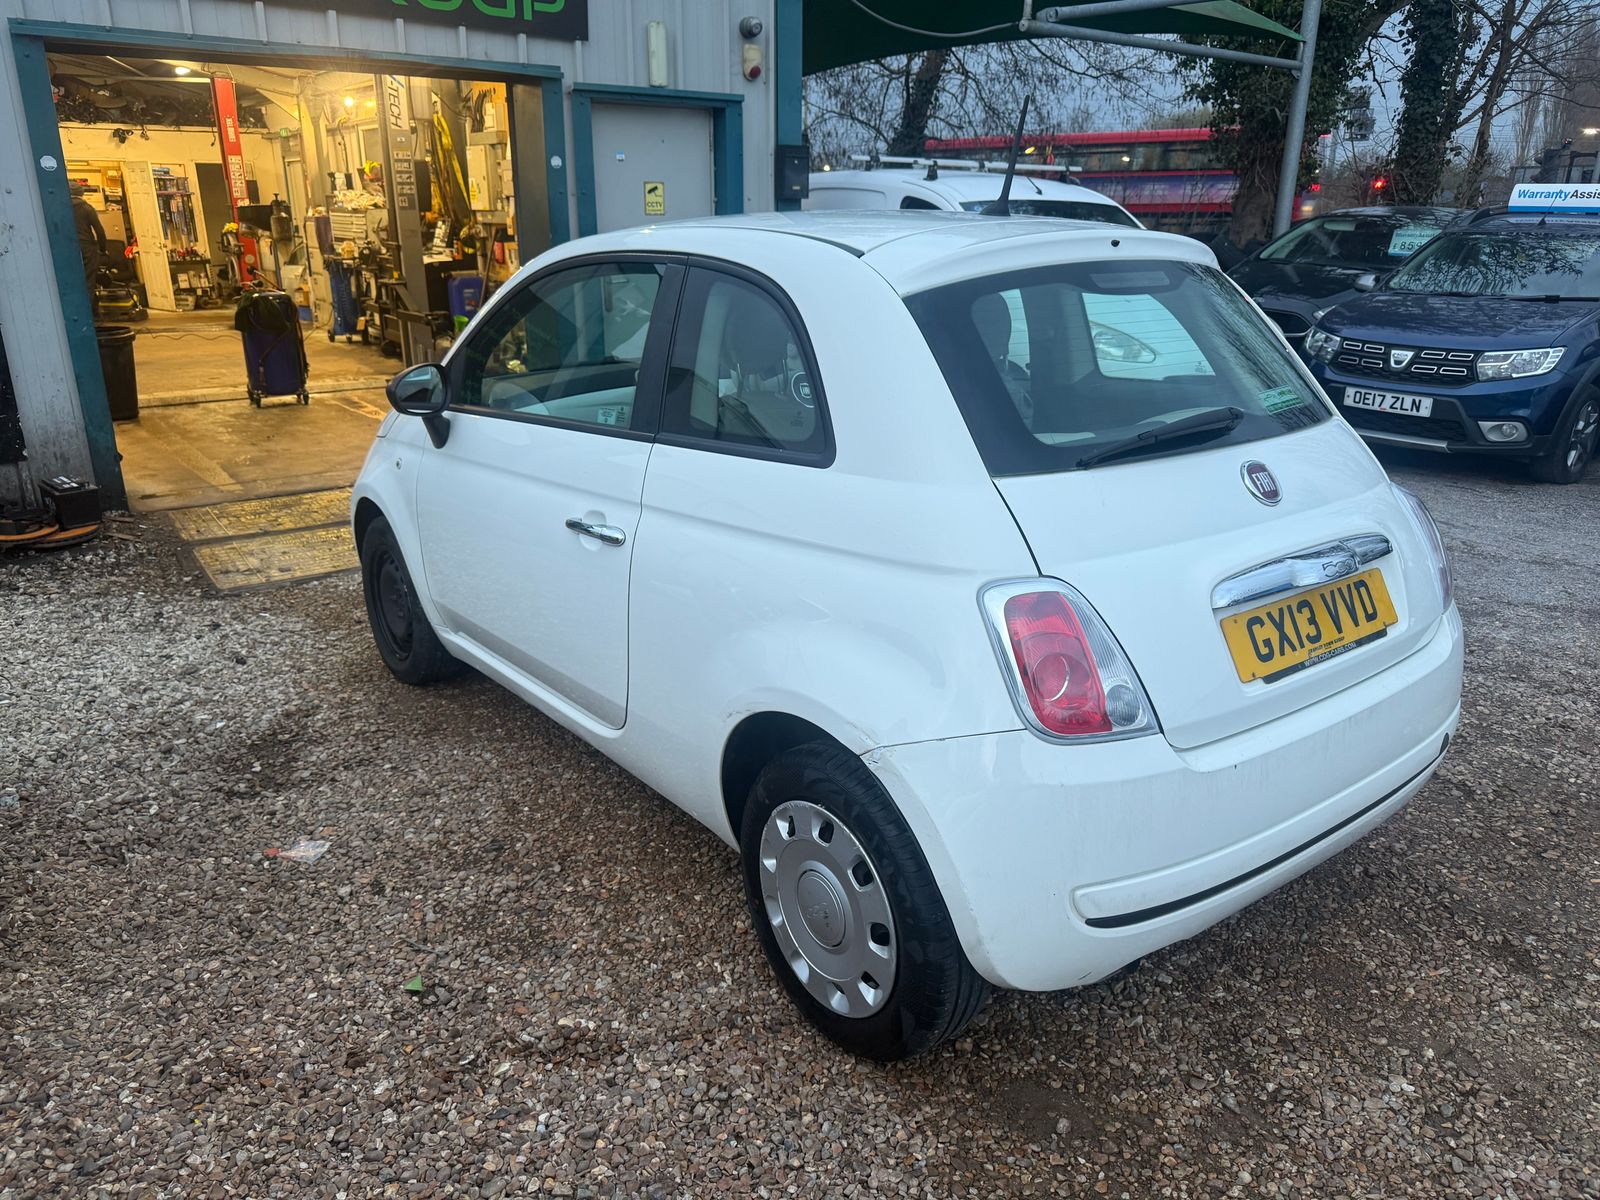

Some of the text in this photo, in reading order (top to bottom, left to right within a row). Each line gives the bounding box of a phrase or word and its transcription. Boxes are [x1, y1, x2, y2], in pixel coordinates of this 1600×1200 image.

[1353, 391, 1422, 413] OE17 ZLN
[1251, 472, 1276, 493] FIAT
[1246, 579, 1378, 663] GX13 VVD
